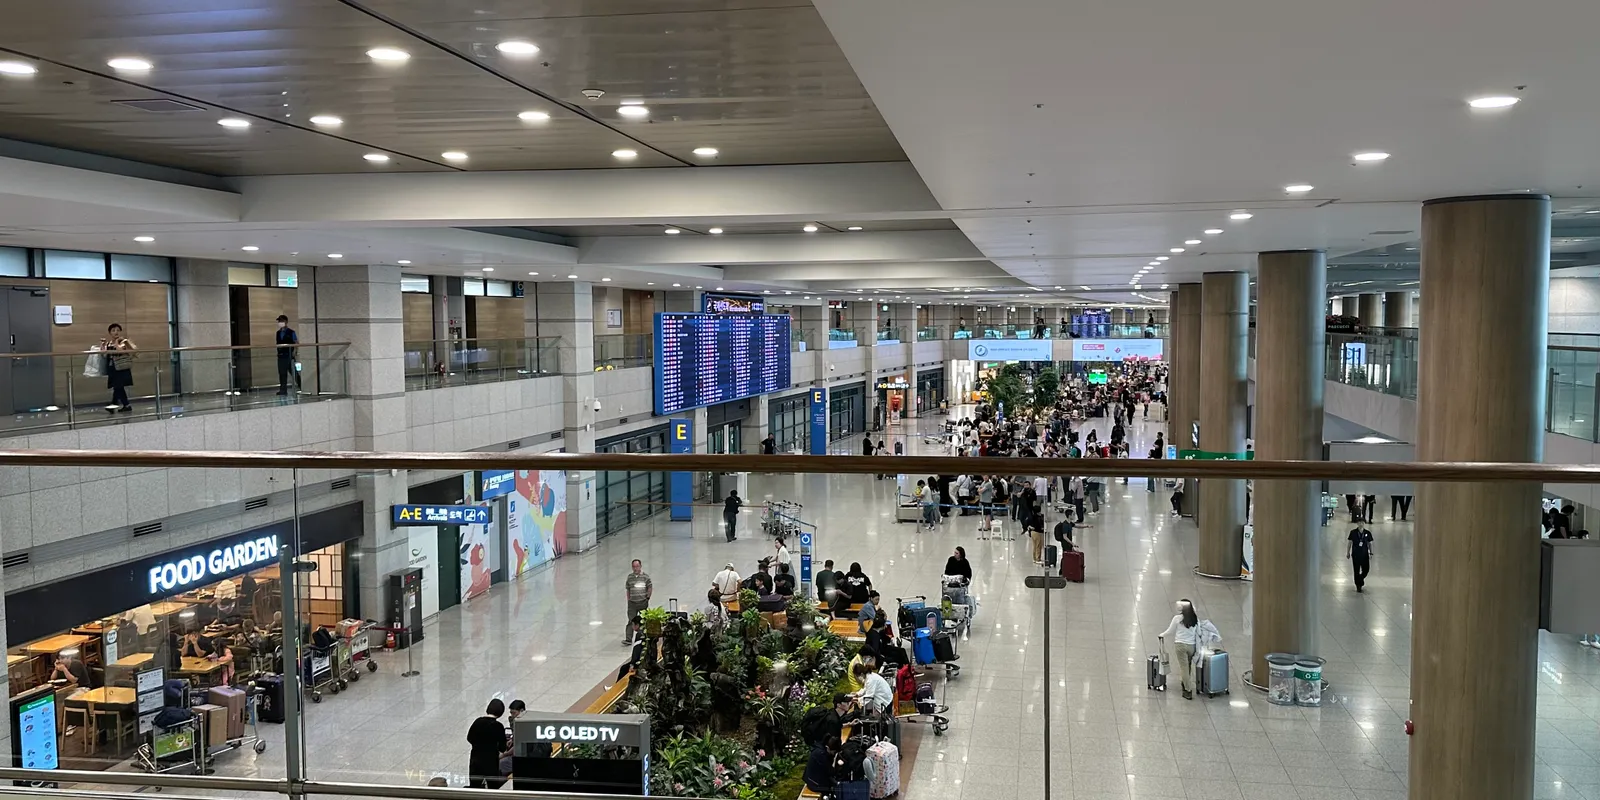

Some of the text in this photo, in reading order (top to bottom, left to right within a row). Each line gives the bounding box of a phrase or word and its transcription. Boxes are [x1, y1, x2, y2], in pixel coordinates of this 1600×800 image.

[814, 391, 822, 403] E
[676, 424, 687, 440] E
[400, 507, 421, 520] A-E
[149, 535, 278, 594] FOOD GARDEN
[536, 725, 619, 741] LG OLED TV
